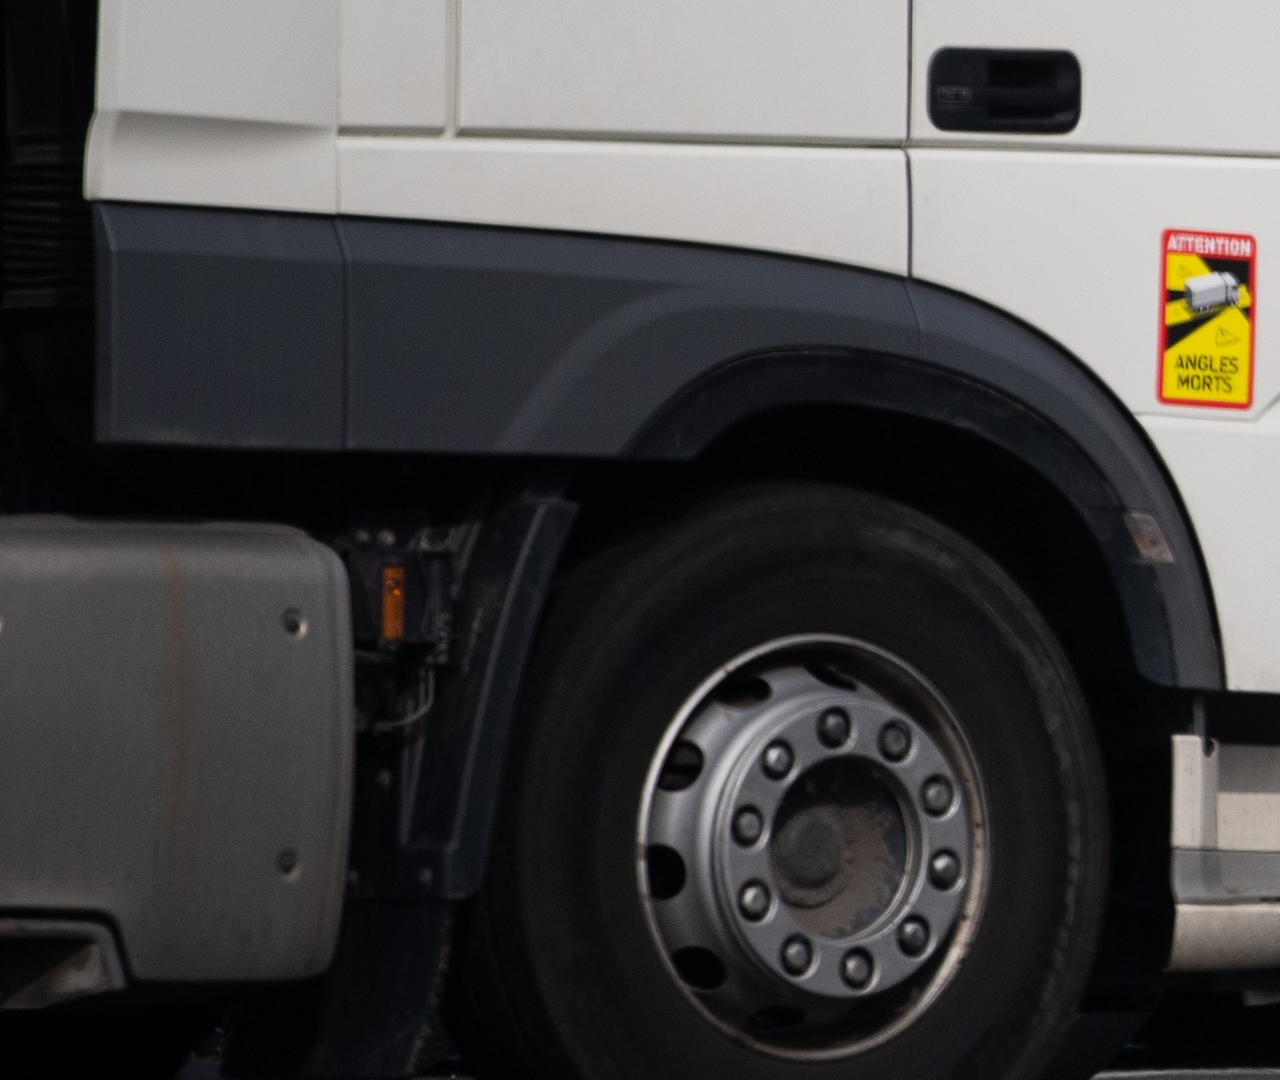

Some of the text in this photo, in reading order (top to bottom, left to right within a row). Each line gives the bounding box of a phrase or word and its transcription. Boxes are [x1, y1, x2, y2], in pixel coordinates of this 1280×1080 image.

[1167, 234, 1251, 258] ATTENTION
[1175, 354, 1239, 375] ANGLES
[1177, 375, 1233, 393] MORTS
